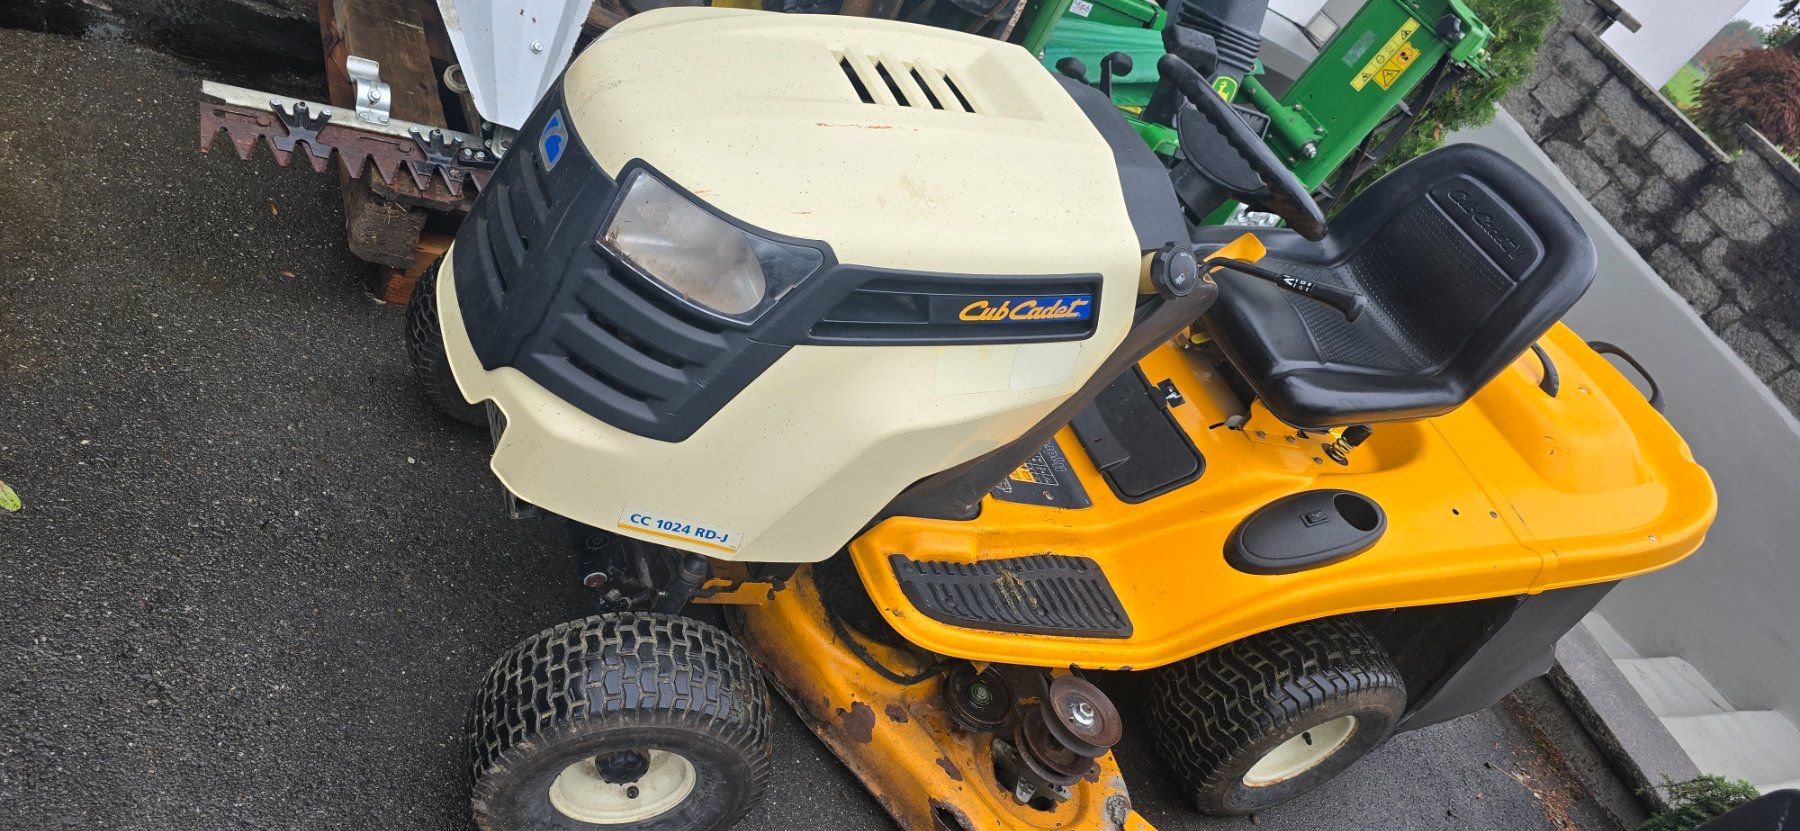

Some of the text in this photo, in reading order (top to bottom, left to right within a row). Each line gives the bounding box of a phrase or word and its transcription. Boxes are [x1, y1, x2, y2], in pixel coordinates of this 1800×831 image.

[959, 298, 1089, 321] Cub Cadet
[630, 513, 729, 543] CC 1024 RD-J
